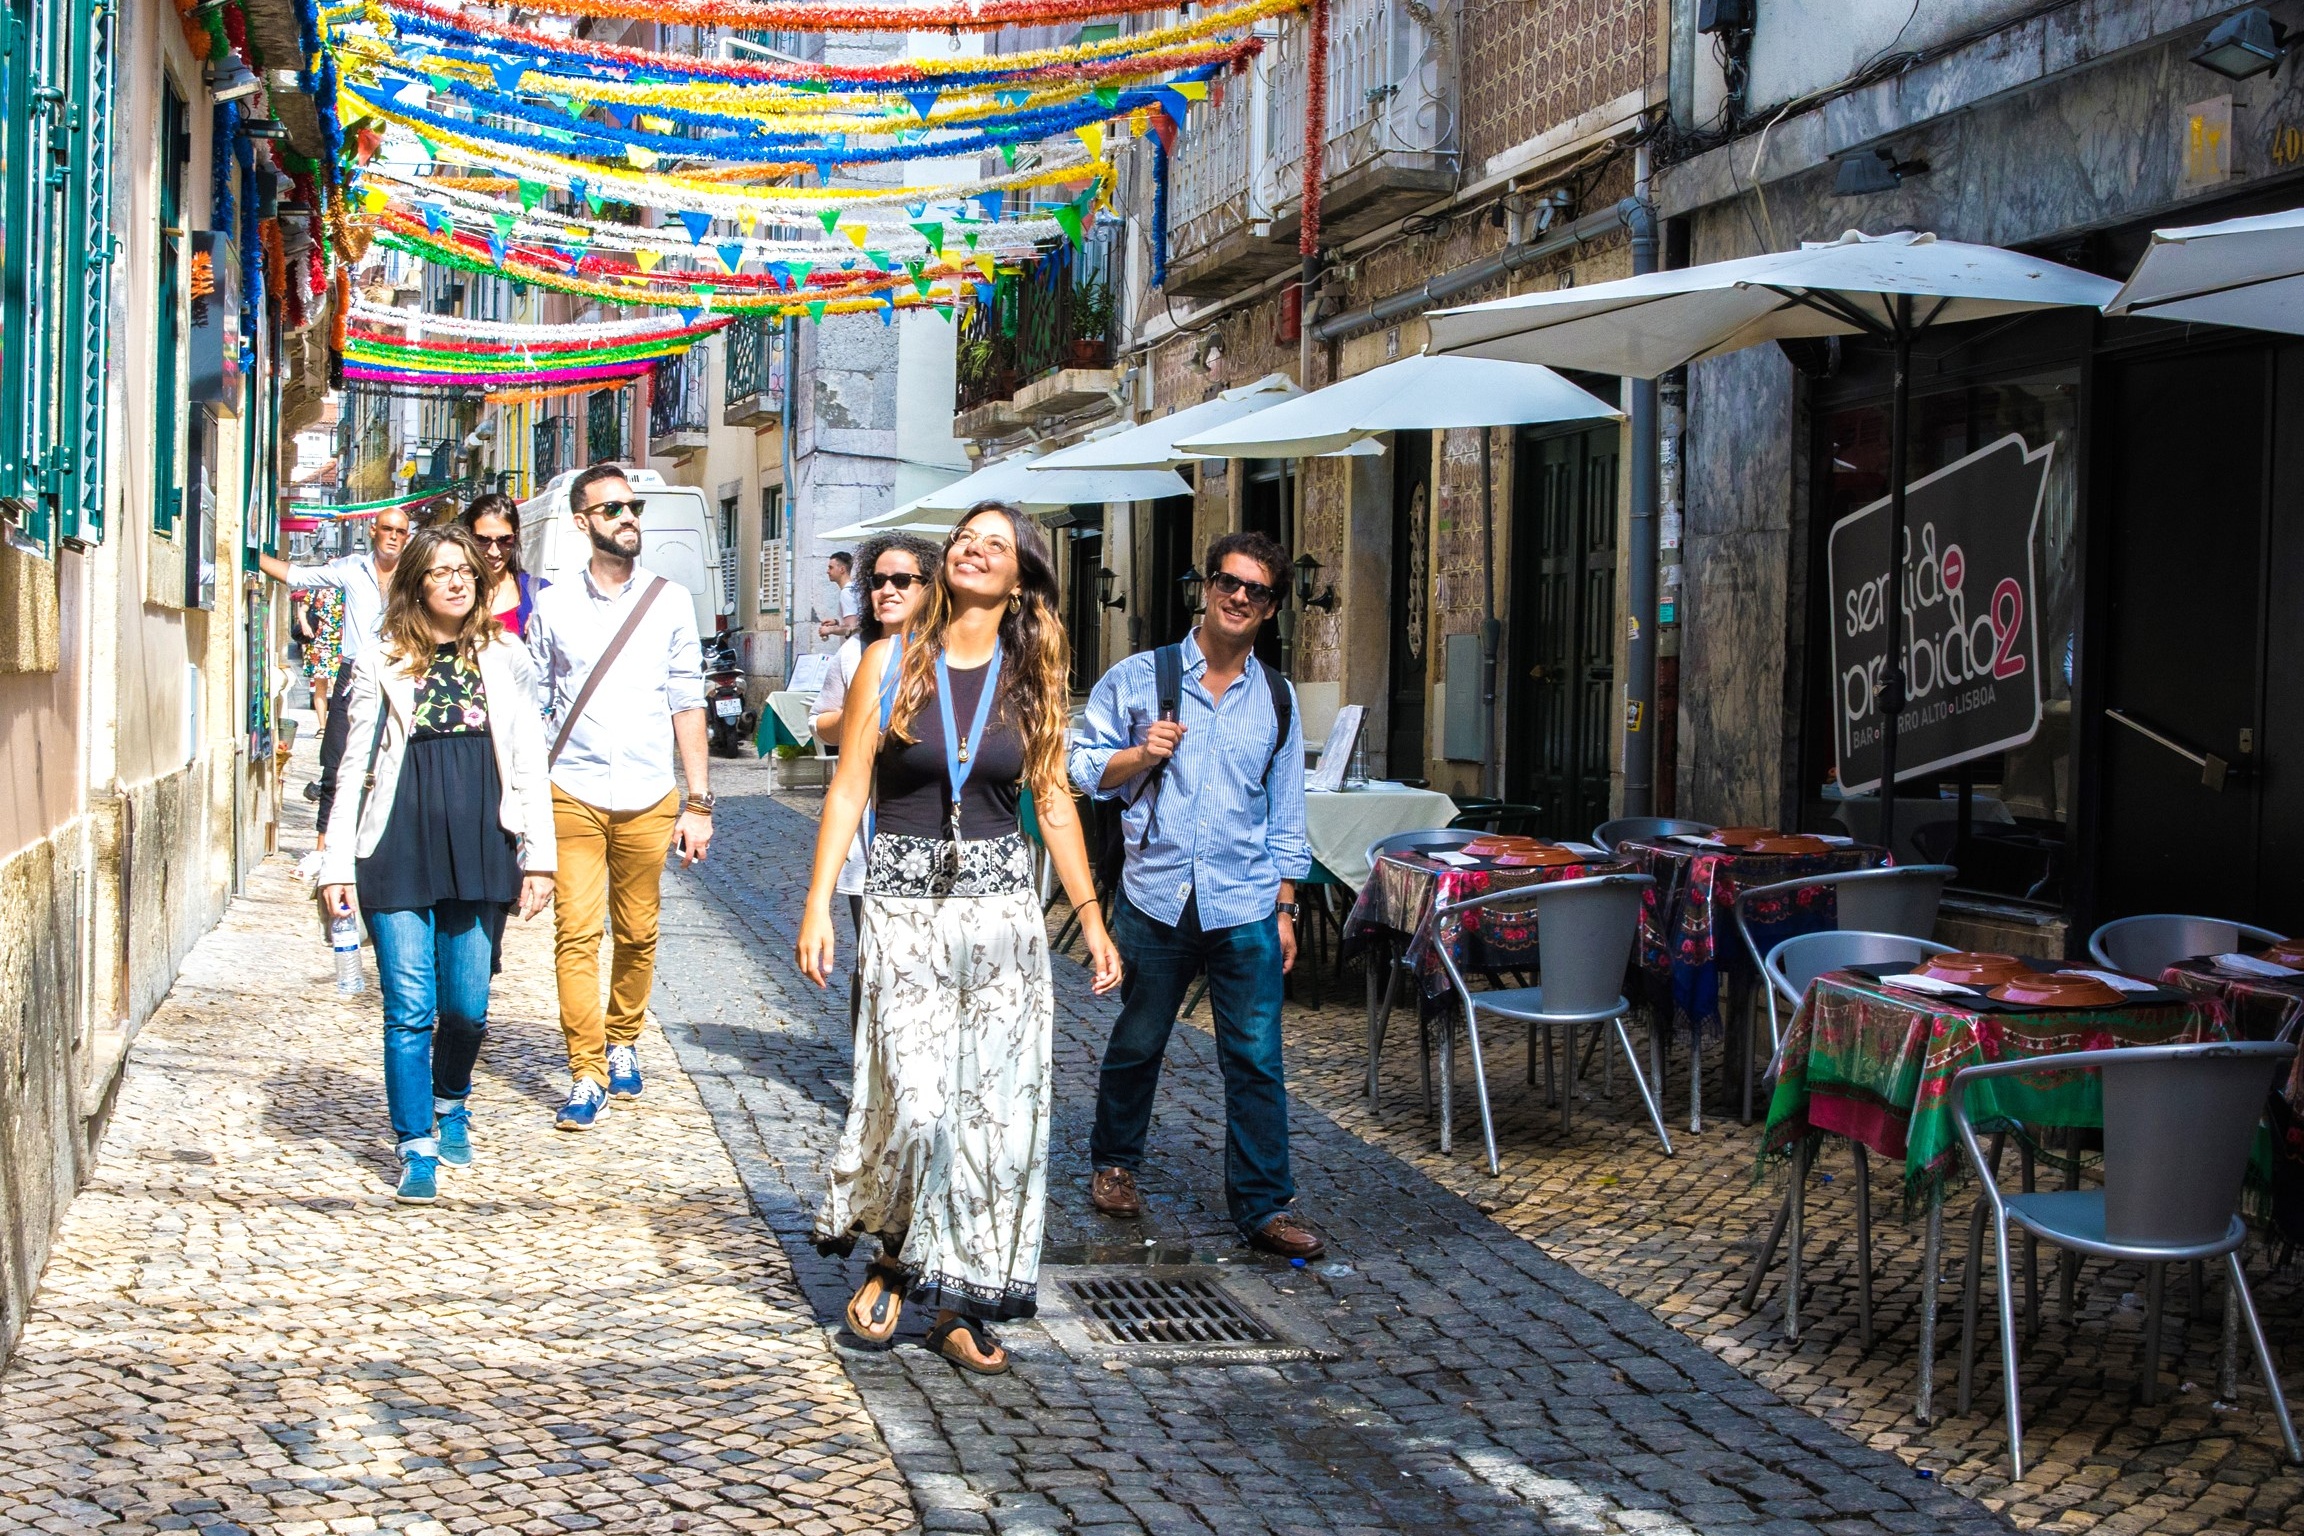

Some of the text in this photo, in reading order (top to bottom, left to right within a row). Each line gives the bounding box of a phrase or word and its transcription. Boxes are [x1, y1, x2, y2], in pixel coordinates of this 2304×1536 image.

[2273, 122, 2304, 168] 40
[1853, 726, 1874, 750] BAR
[1920, 700, 1948, 727] ALTO
[1955, 683, 1996, 715] LISBOA
